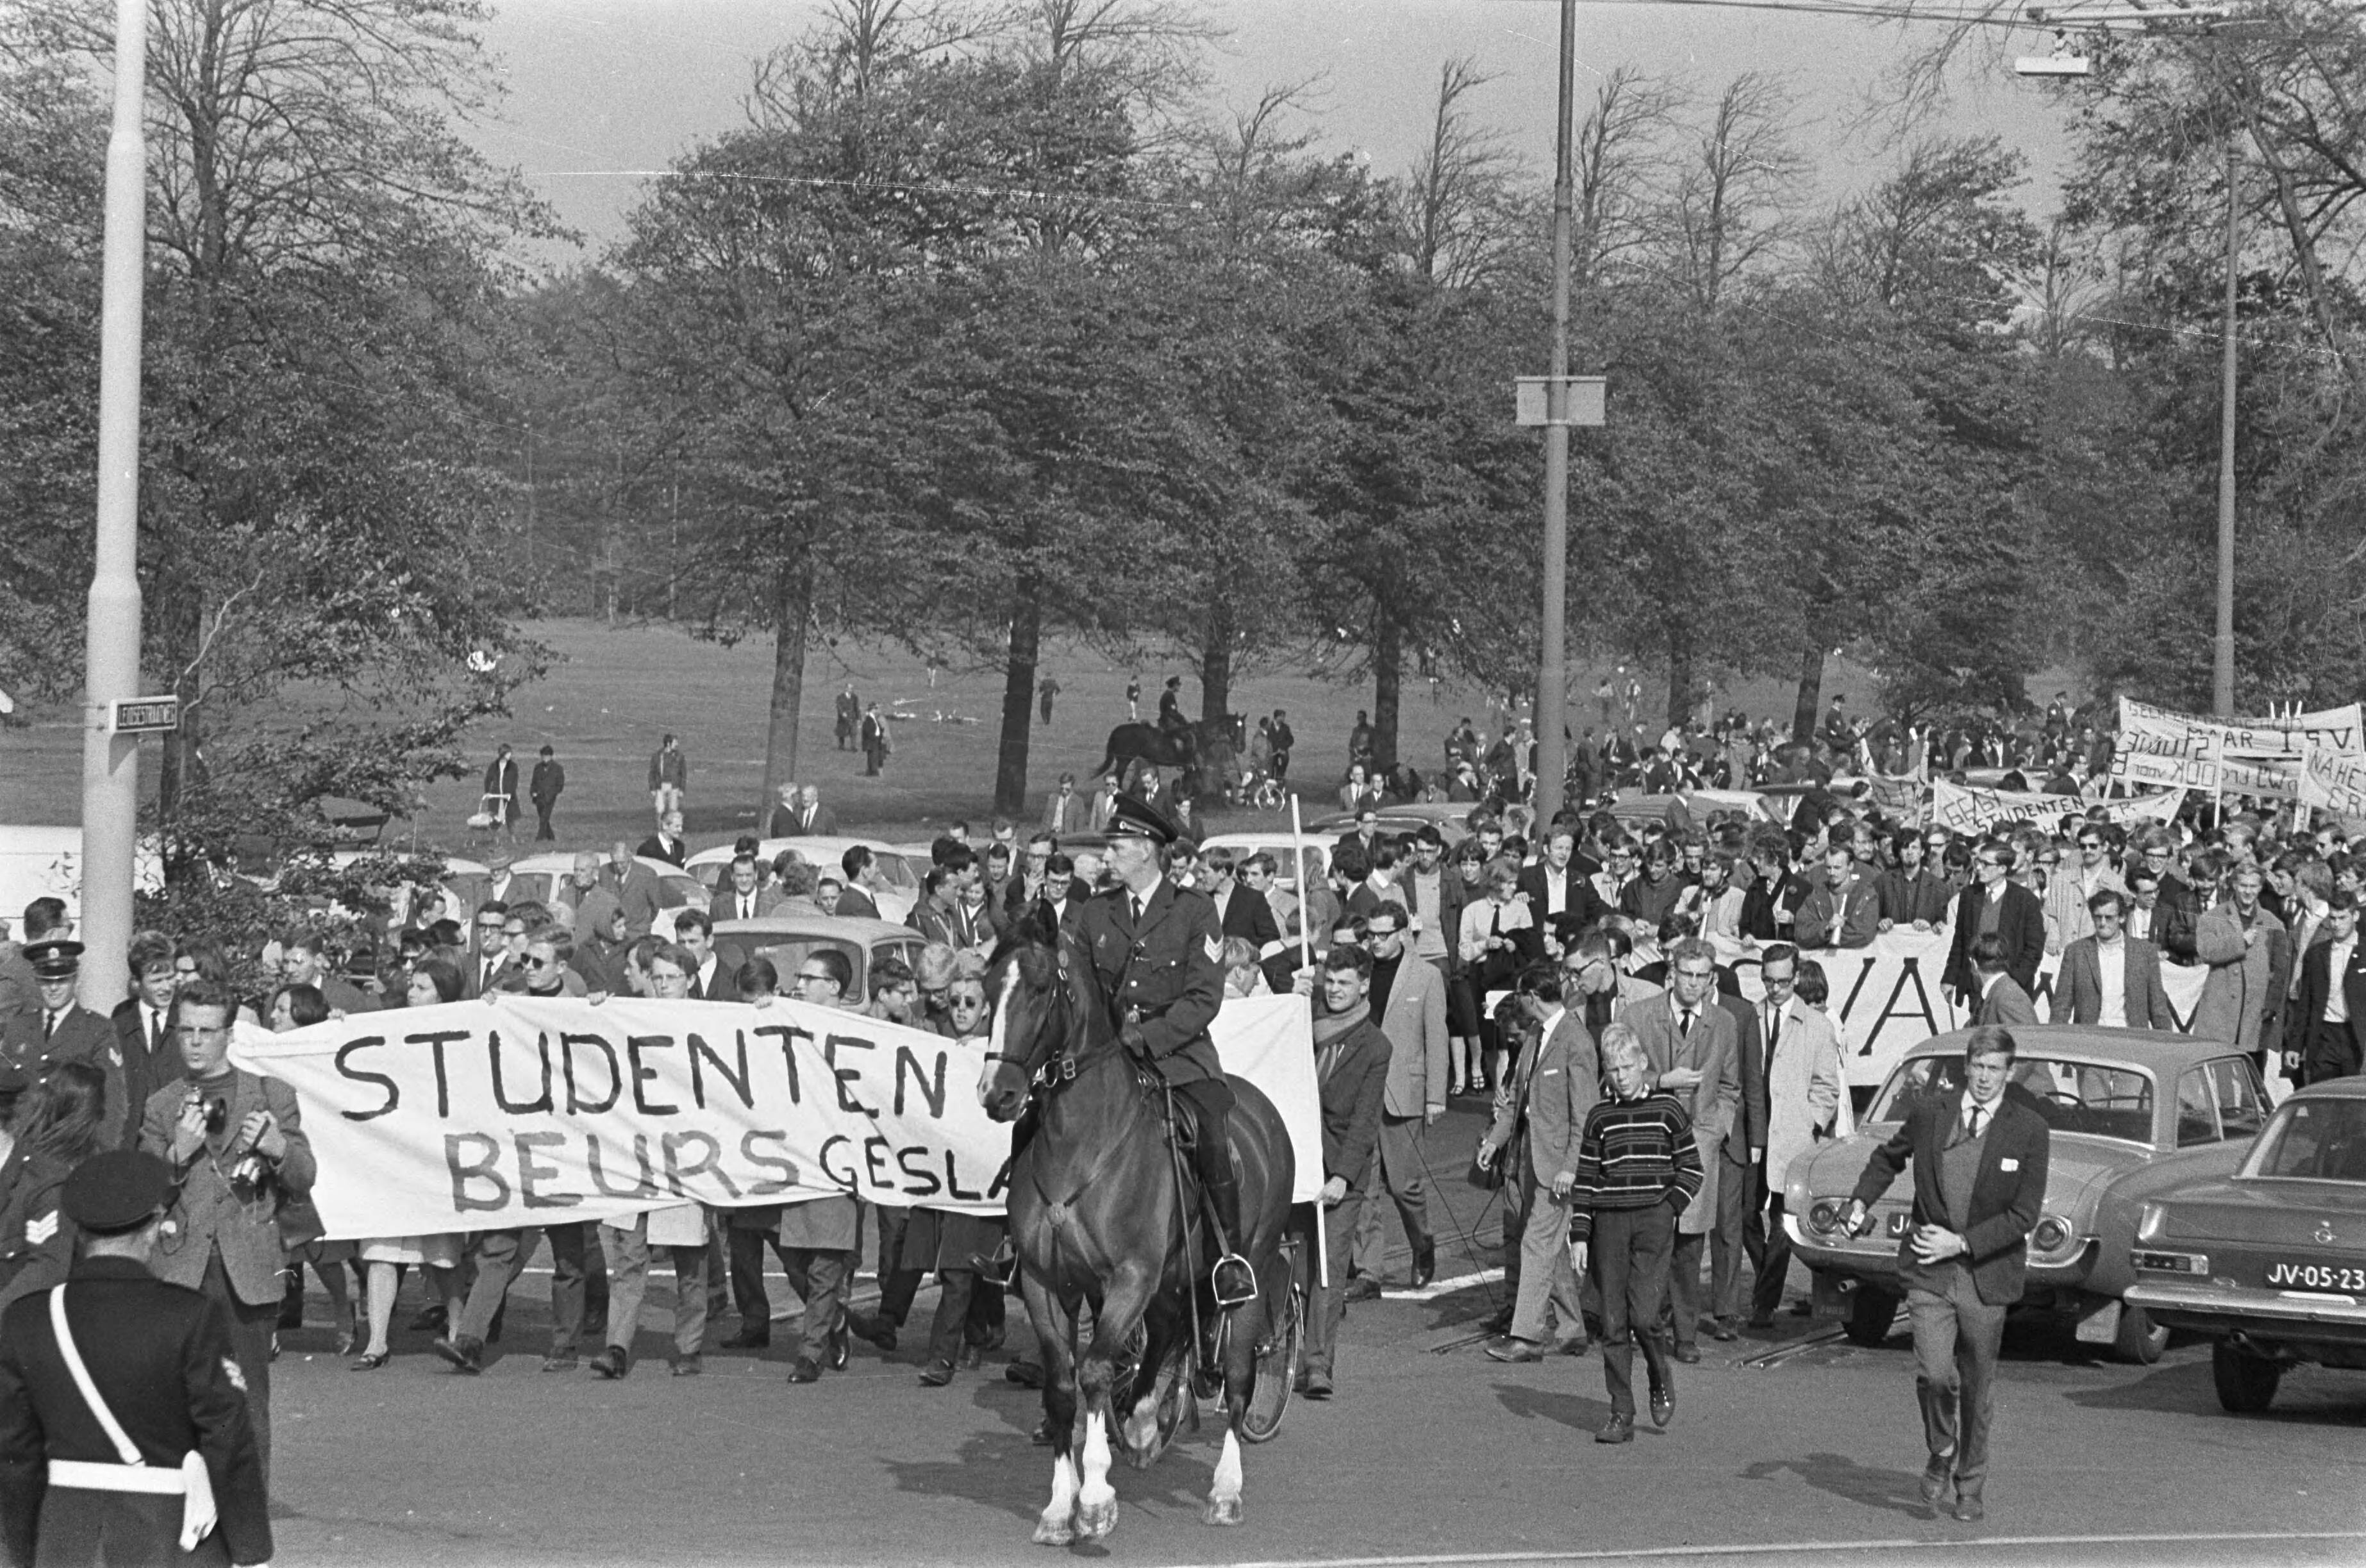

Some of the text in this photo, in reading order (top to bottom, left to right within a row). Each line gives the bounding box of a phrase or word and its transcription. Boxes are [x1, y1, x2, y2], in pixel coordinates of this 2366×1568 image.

[335, 1026, 947, 1121] STUDENTEN
[444, 1130, 800, 1213] BEURS
[2267, 1263, 2366, 1290] JV-05-23
